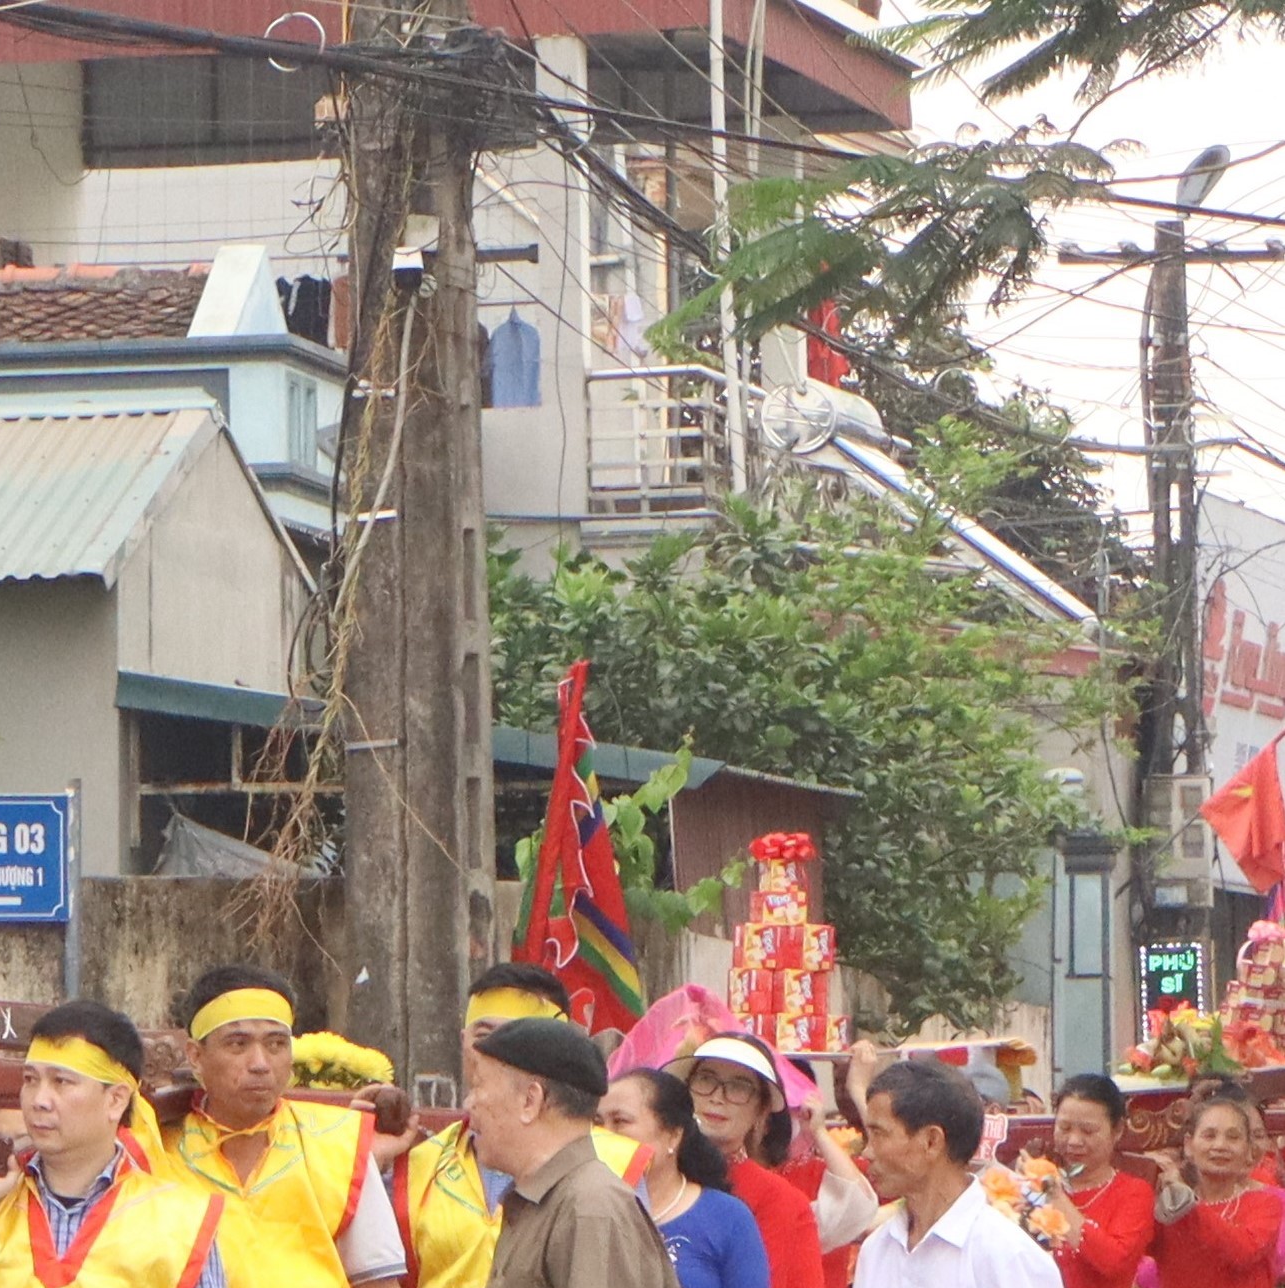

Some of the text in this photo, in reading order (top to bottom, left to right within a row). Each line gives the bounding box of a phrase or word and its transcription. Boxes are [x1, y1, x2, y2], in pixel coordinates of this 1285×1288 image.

[14, 823, 46, 855] 03
[37, 868, 44, 887] 1
[766, 893, 792, 907] Tipo
[1148, 949, 1195, 972] PHÚ
